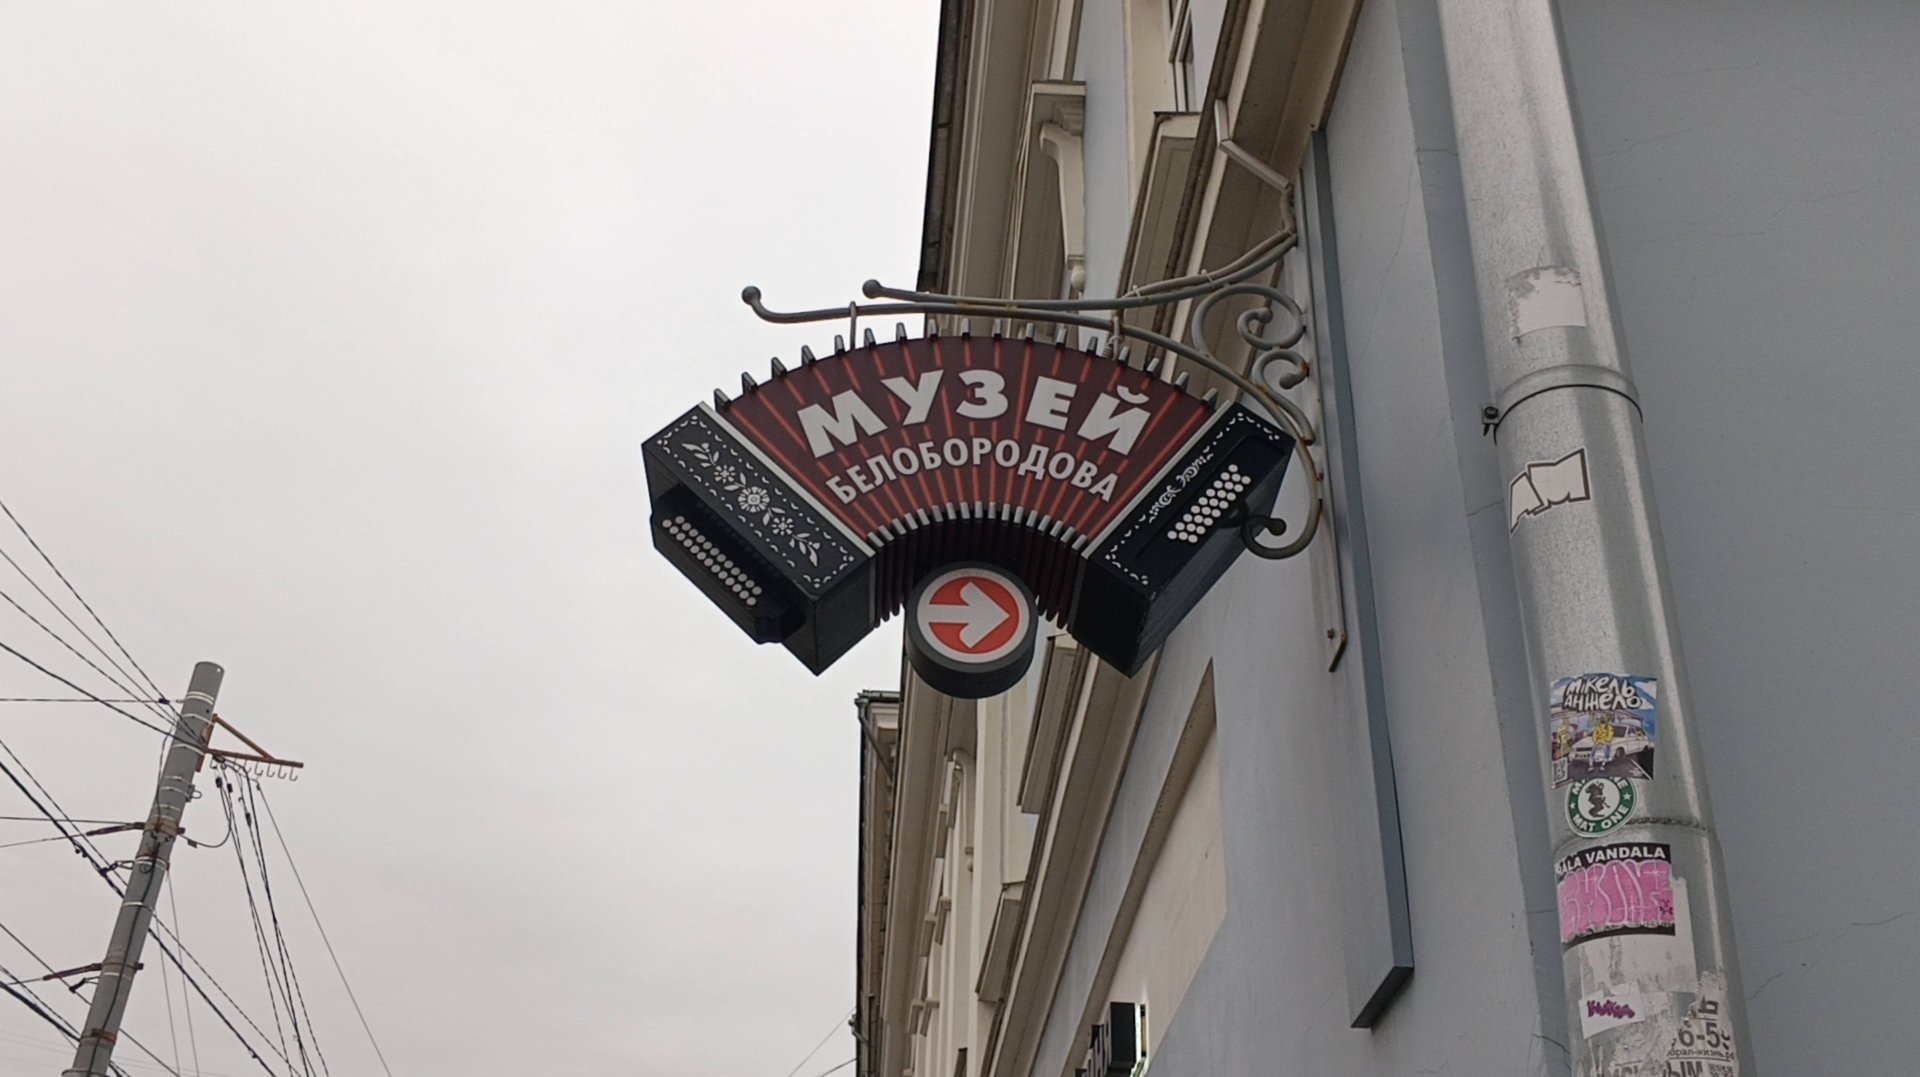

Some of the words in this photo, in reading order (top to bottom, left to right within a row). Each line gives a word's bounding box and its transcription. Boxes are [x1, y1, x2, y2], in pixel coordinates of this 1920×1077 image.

[797, 369, 1151, 458] МУЗЕЙ
[826, 437, 1119, 504] БЕЛОБОРОДОВА
[1572, 814, 1595, 832] MAT
[1601, 804, 1629, 829] ONE
[1586, 846, 1666, 863] VANDALA
